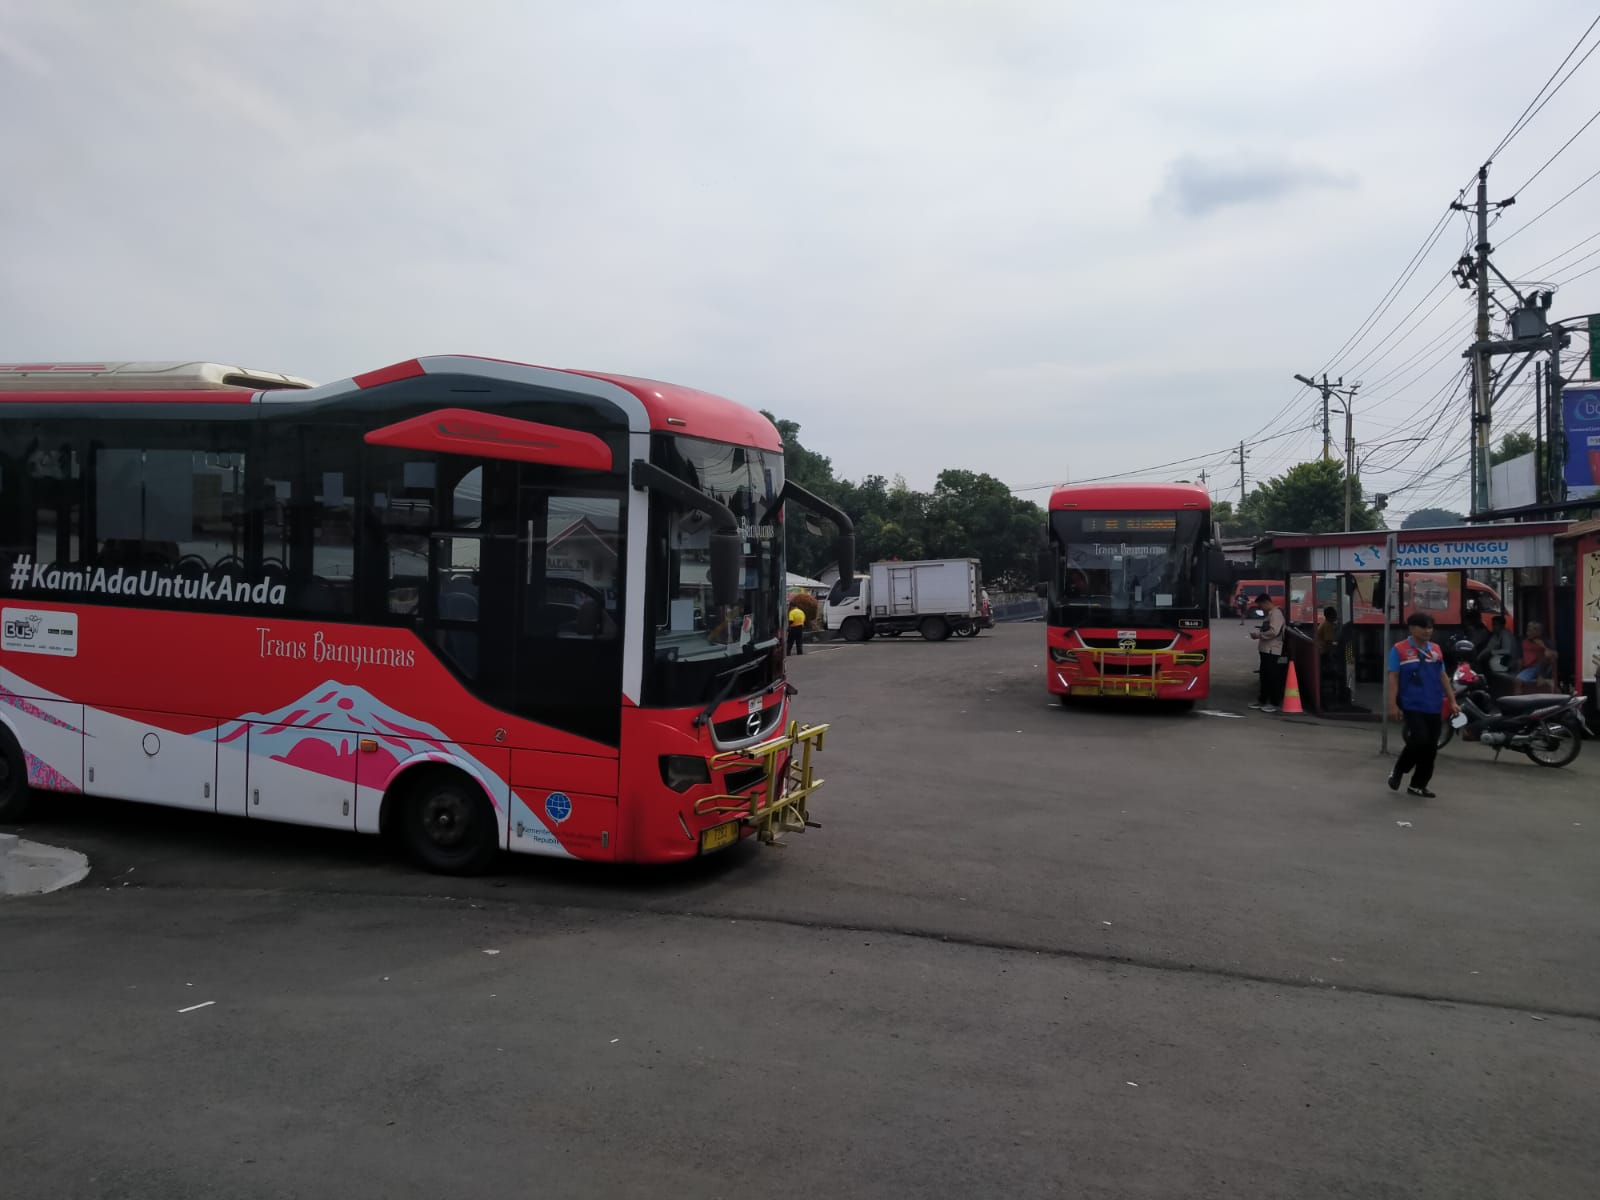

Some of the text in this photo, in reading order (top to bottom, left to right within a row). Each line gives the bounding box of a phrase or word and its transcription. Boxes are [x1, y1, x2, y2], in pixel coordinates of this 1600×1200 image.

[1396, 555, 1508, 567] RANS BANYUMAS
[1397, 542, 1508, 554] UANG TUNGGU
[10, 553, 287, 605] #KamiAdaUntukAnda
[256, 627, 415, 671] Trans Banyumas
